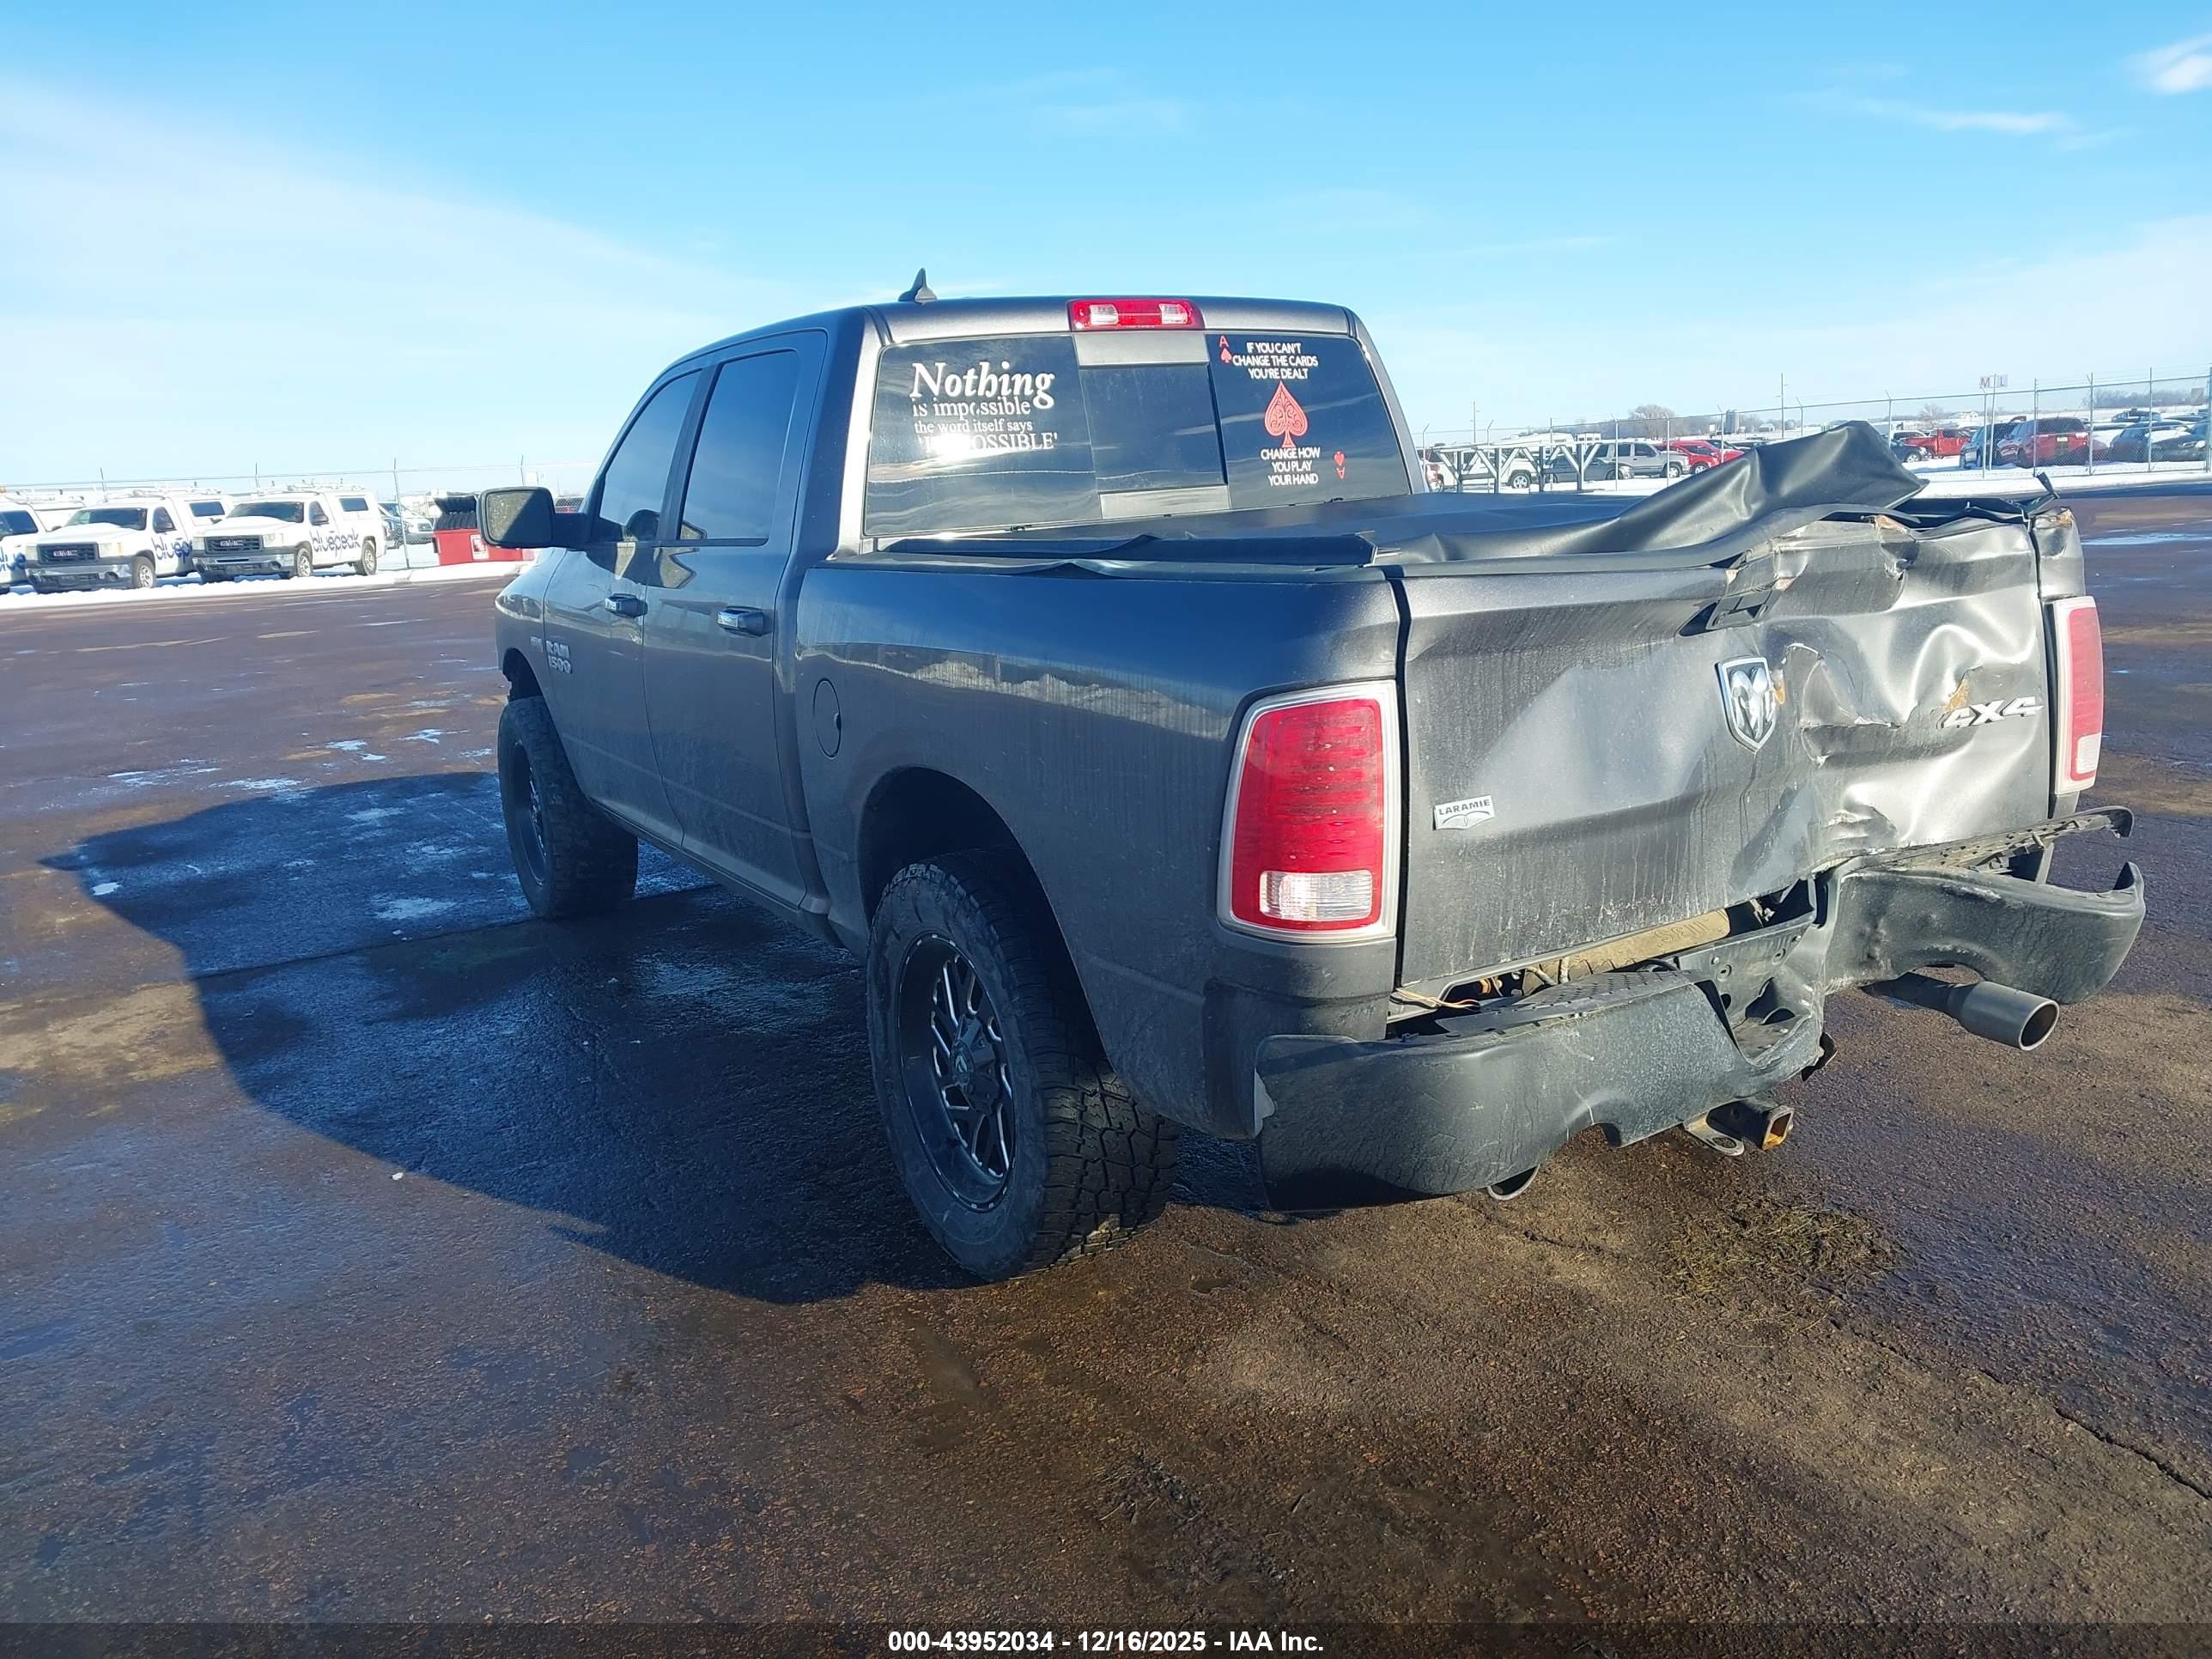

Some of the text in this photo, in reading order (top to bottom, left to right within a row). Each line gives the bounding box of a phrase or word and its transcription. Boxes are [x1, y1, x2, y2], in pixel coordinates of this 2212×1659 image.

[1247, 343, 1302, 354] IF YOU CAN'T
[1232, 356, 1318, 367] CHANGE THE CARDS
[1249, 368, 1309, 380] YOU'RE DEALT
[909, 361, 1055, 410] Nothing
[912, 398, 927, 416] is
[914, 418, 1033, 436] the word itself says
[1261, 447, 1320, 460] CHANGE HOW
[1272, 460, 1313, 472] YOU PLAY
[1268, 473, 1319, 486] YOUR HAND
[310, 528, 362, 558] bluepeak
[1438, 799, 1490, 815] LARAMIE
